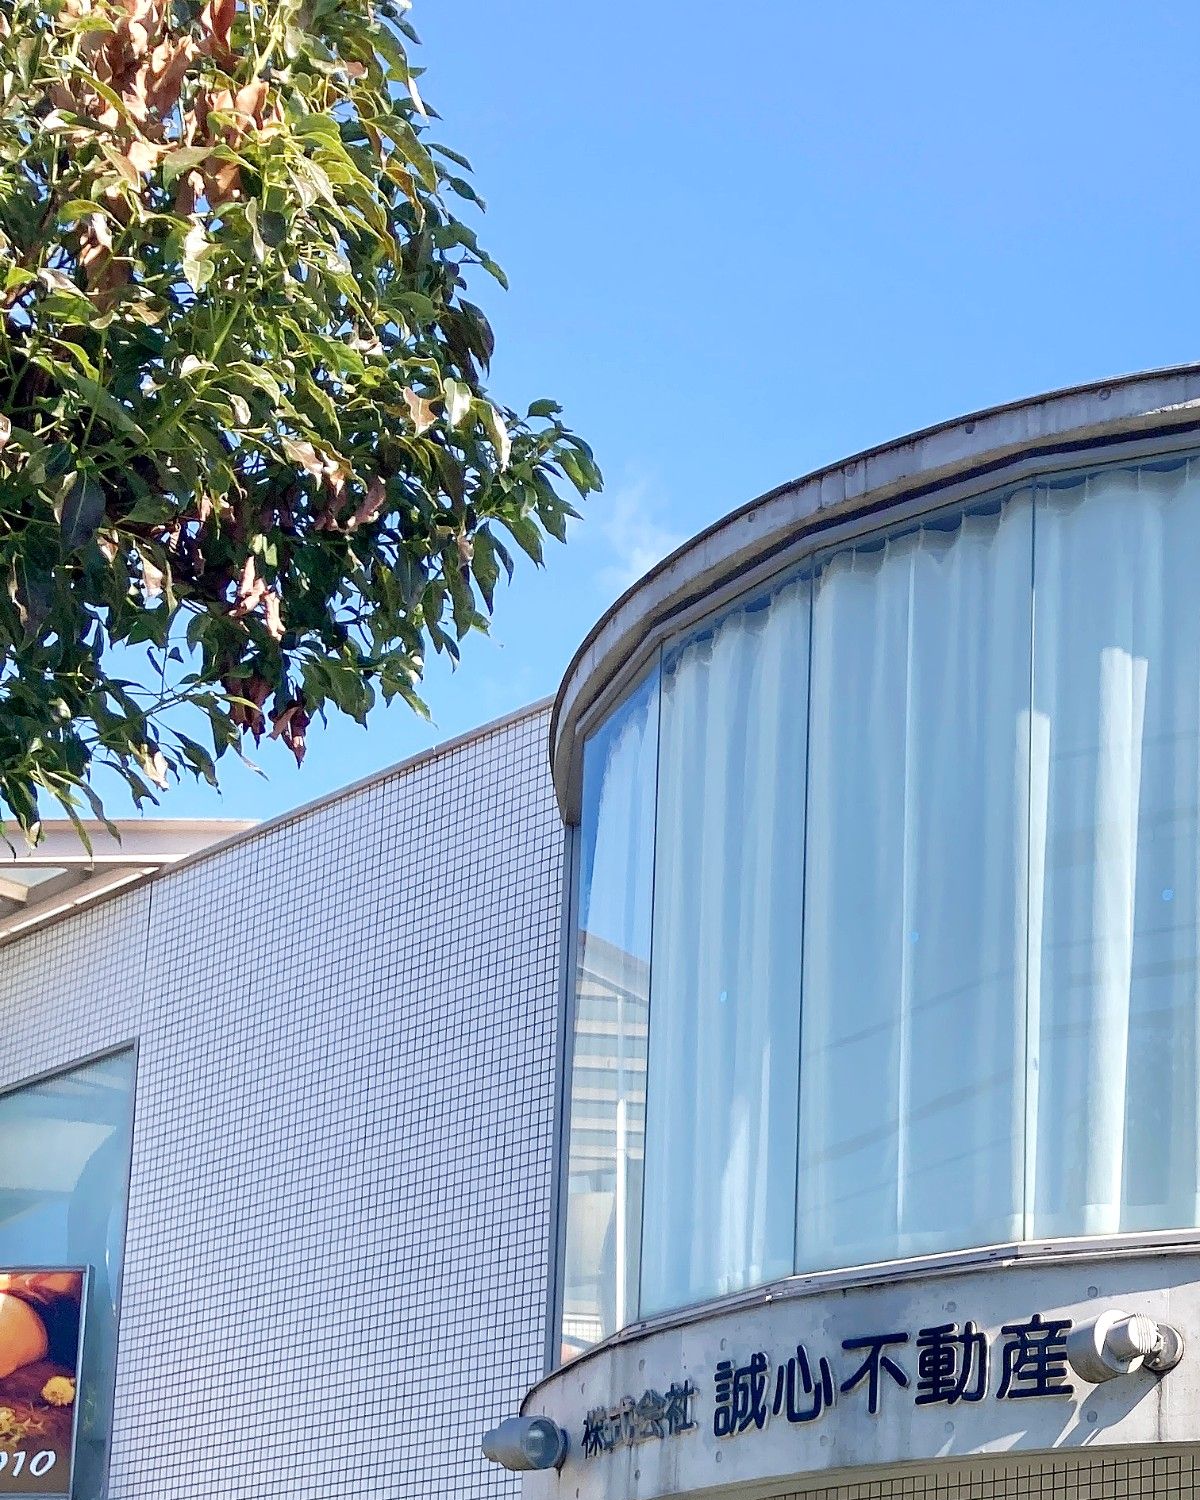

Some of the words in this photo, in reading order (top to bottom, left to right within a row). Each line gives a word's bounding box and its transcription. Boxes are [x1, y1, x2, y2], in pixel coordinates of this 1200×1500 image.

[580, 1379, 699, 1460] 株式会社
[712, 1312, 1075, 1439] 誠心不動産
